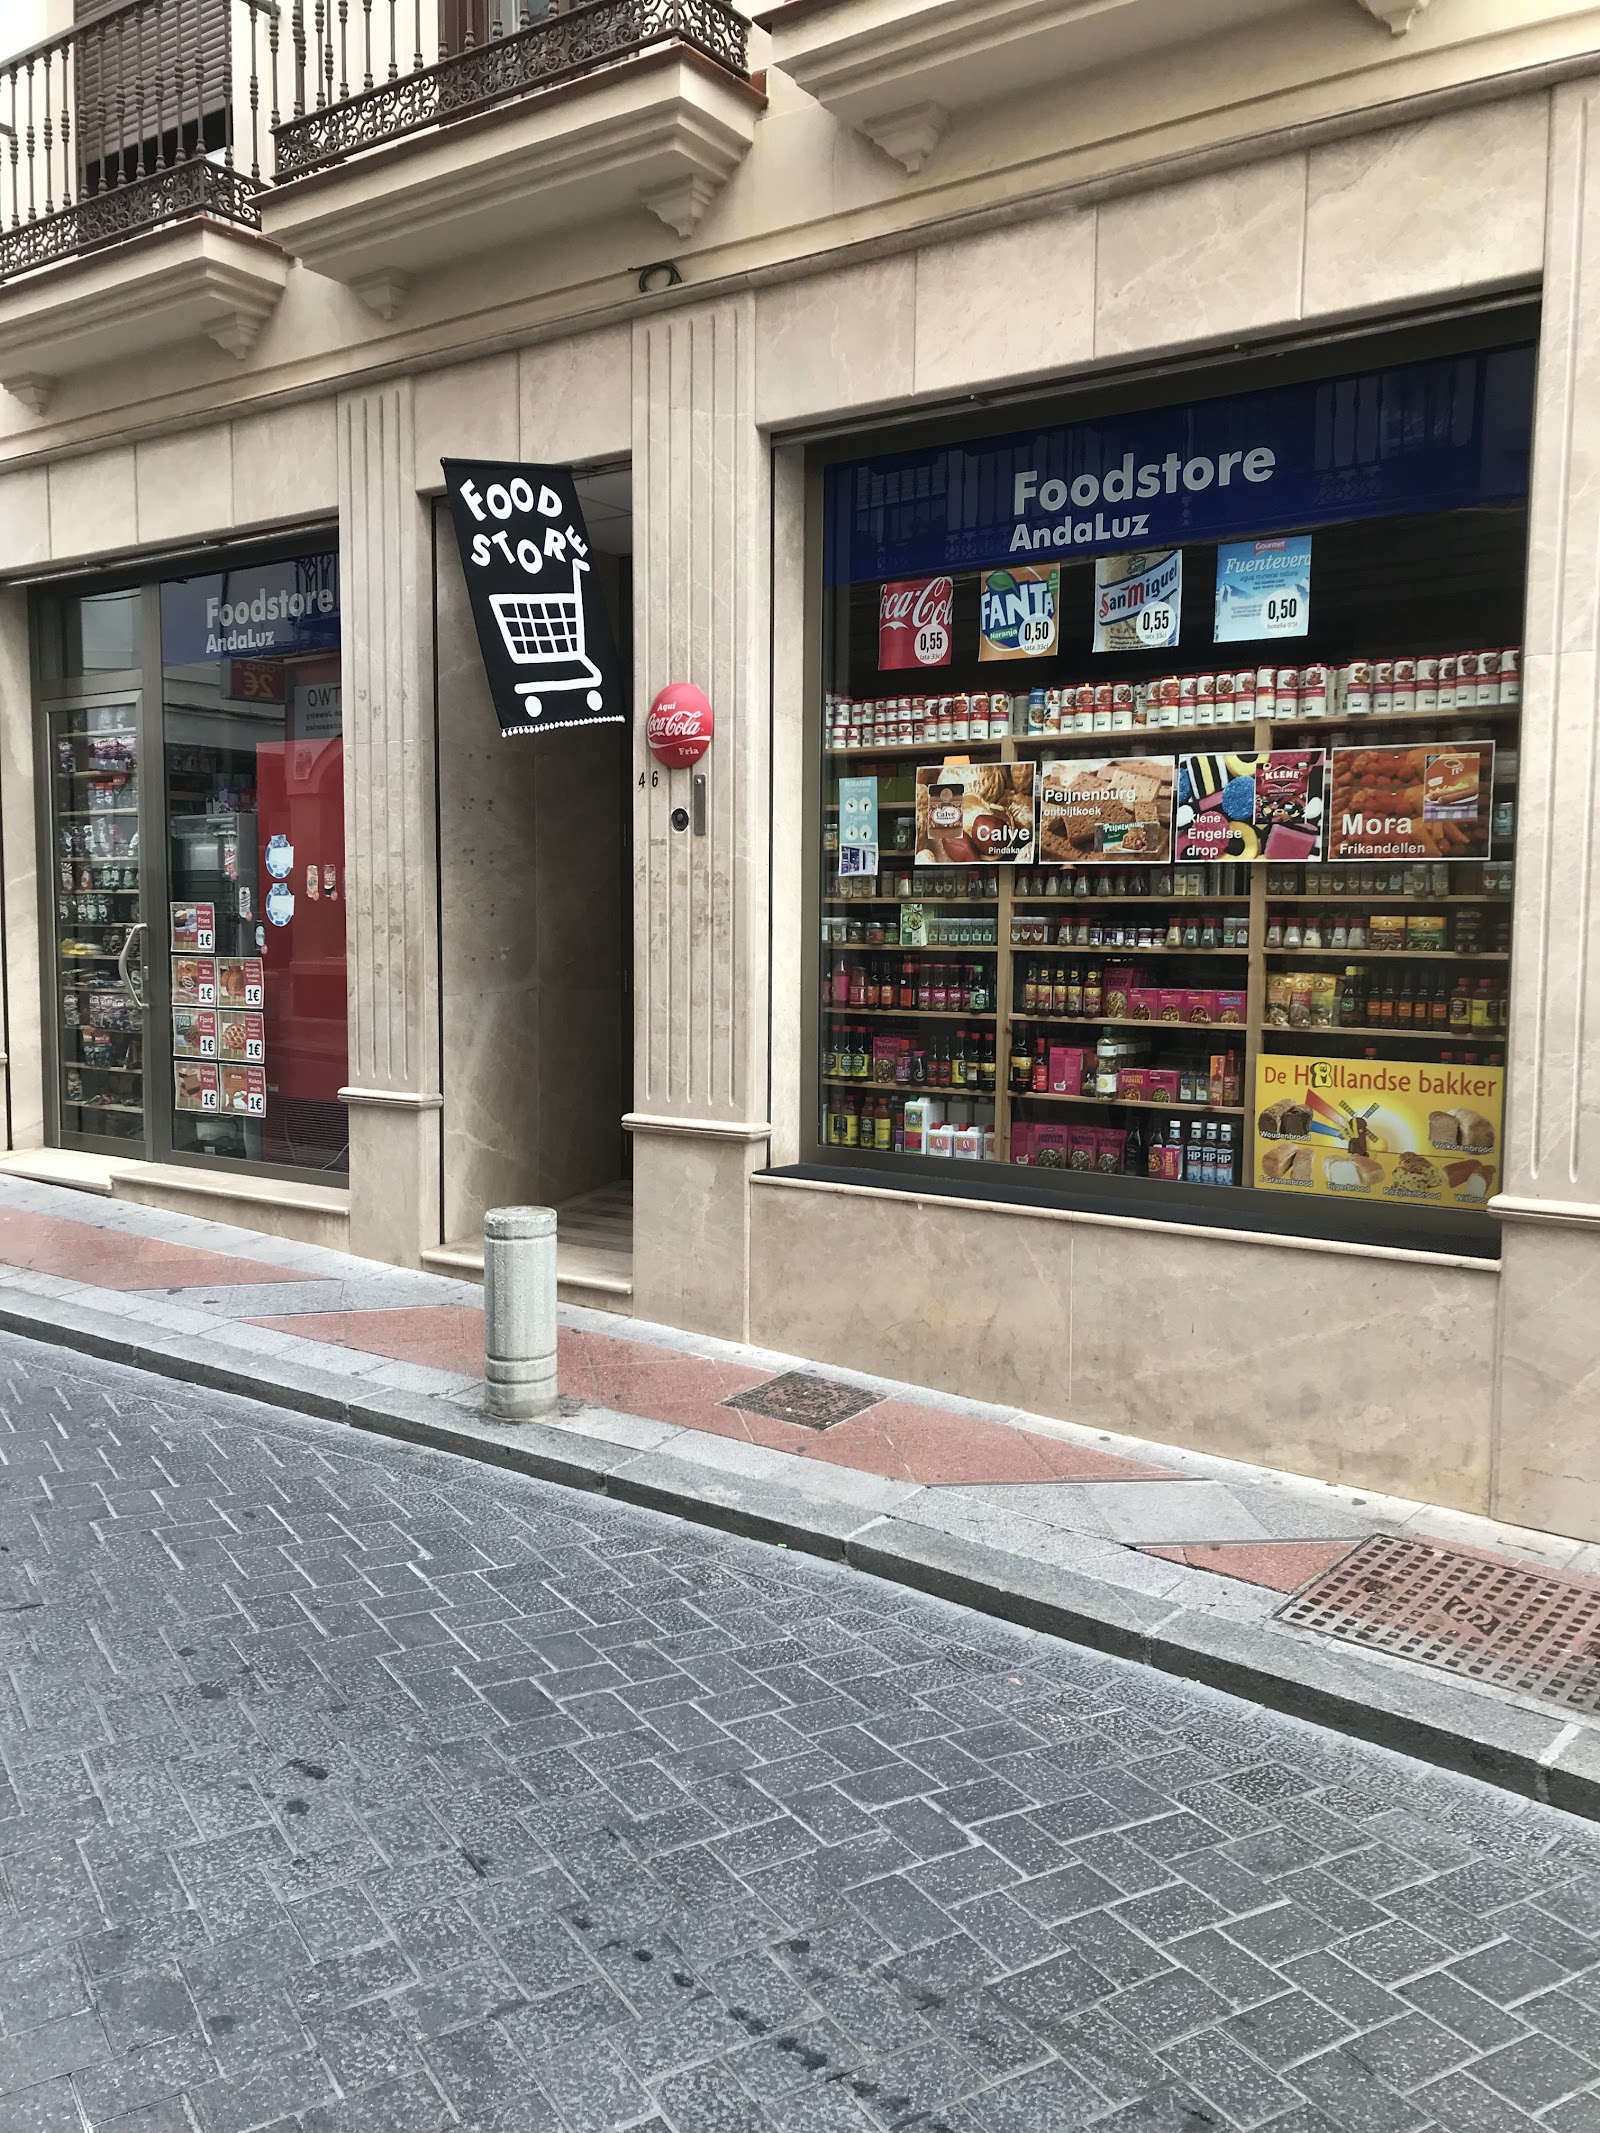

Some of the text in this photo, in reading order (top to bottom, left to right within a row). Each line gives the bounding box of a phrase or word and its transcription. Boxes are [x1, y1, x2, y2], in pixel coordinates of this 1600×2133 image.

[1014, 447, 1276, 516] Foodstore
[459, 477, 563, 521] FOOD
[1009, 512, 1150, 552] AndaLuz
[470, 524, 589, 574] STORE
[1255, 540, 1285, 550] Gourmet
[1240, 570, 1299, 583] agua mineral natural
[1098, 559, 1177, 619] San Miguel
[206, 588, 334, 628] Foodstore
[980, 583, 1055, 630] FANTA
[1268, 598, 1297, 622] 0,50
[1142, 610, 1169, 633] 0,55
[990, 628, 1018, 639] Naranja
[1024, 621, 1048, 643] 0,50
[205, 628, 274, 653] AndaLuz
[920, 631, 943, 653] 0,55
[1024, 643, 1035, 651] lata
[919, 653, 930, 661] lata
[1264, 770, 1300, 781] KLENE
[1044, 787, 1136, 805] Peijnenburg
[1043, 805, 1101, 819] ontbijtkoek
[1190, 813, 1221, 823] Klene
[1341, 813, 1411, 836] Mora
[976, 824, 1030, 842] Calve
[1187, 828, 1242, 842] Engelse
[1186, 845, 1219, 858] drop
[1339, 842, 1425, 855] Frikandellen
[199, 933, 211, 946] 1€
[200, 987, 213, 1000] 1€
[247, 989, 260, 1001] 1€
[199, 1016, 214, 1024] Fjord
[202, 1039, 214, 1052] 1€
[248, 1043, 261, 1056] 1€
[1264, 1066, 1287, 1085] De
[1419, 1069, 1497, 1097] bakker
[203, 1093, 216, 1106] 1€
[249, 1097, 262, 1110] 1€
[1260, 1130, 1311, 1142] Woudenbrood
[1434, 1141, 1494, 1154] Volkorenbrood
[1187, 1150, 1201, 1161] HP
[1202, 1152, 1216, 1162] HP
[1217, 1153, 1231, 1164] HP
[1265, 1176, 1313, 1188] Granenbrood
[1327, 1182, 1370, 1194] Tijgerbrood
[1383, 1187, 1441, 1200] Rozijnenbrood
[1455, 1194, 1489, 1204] Witbroo
